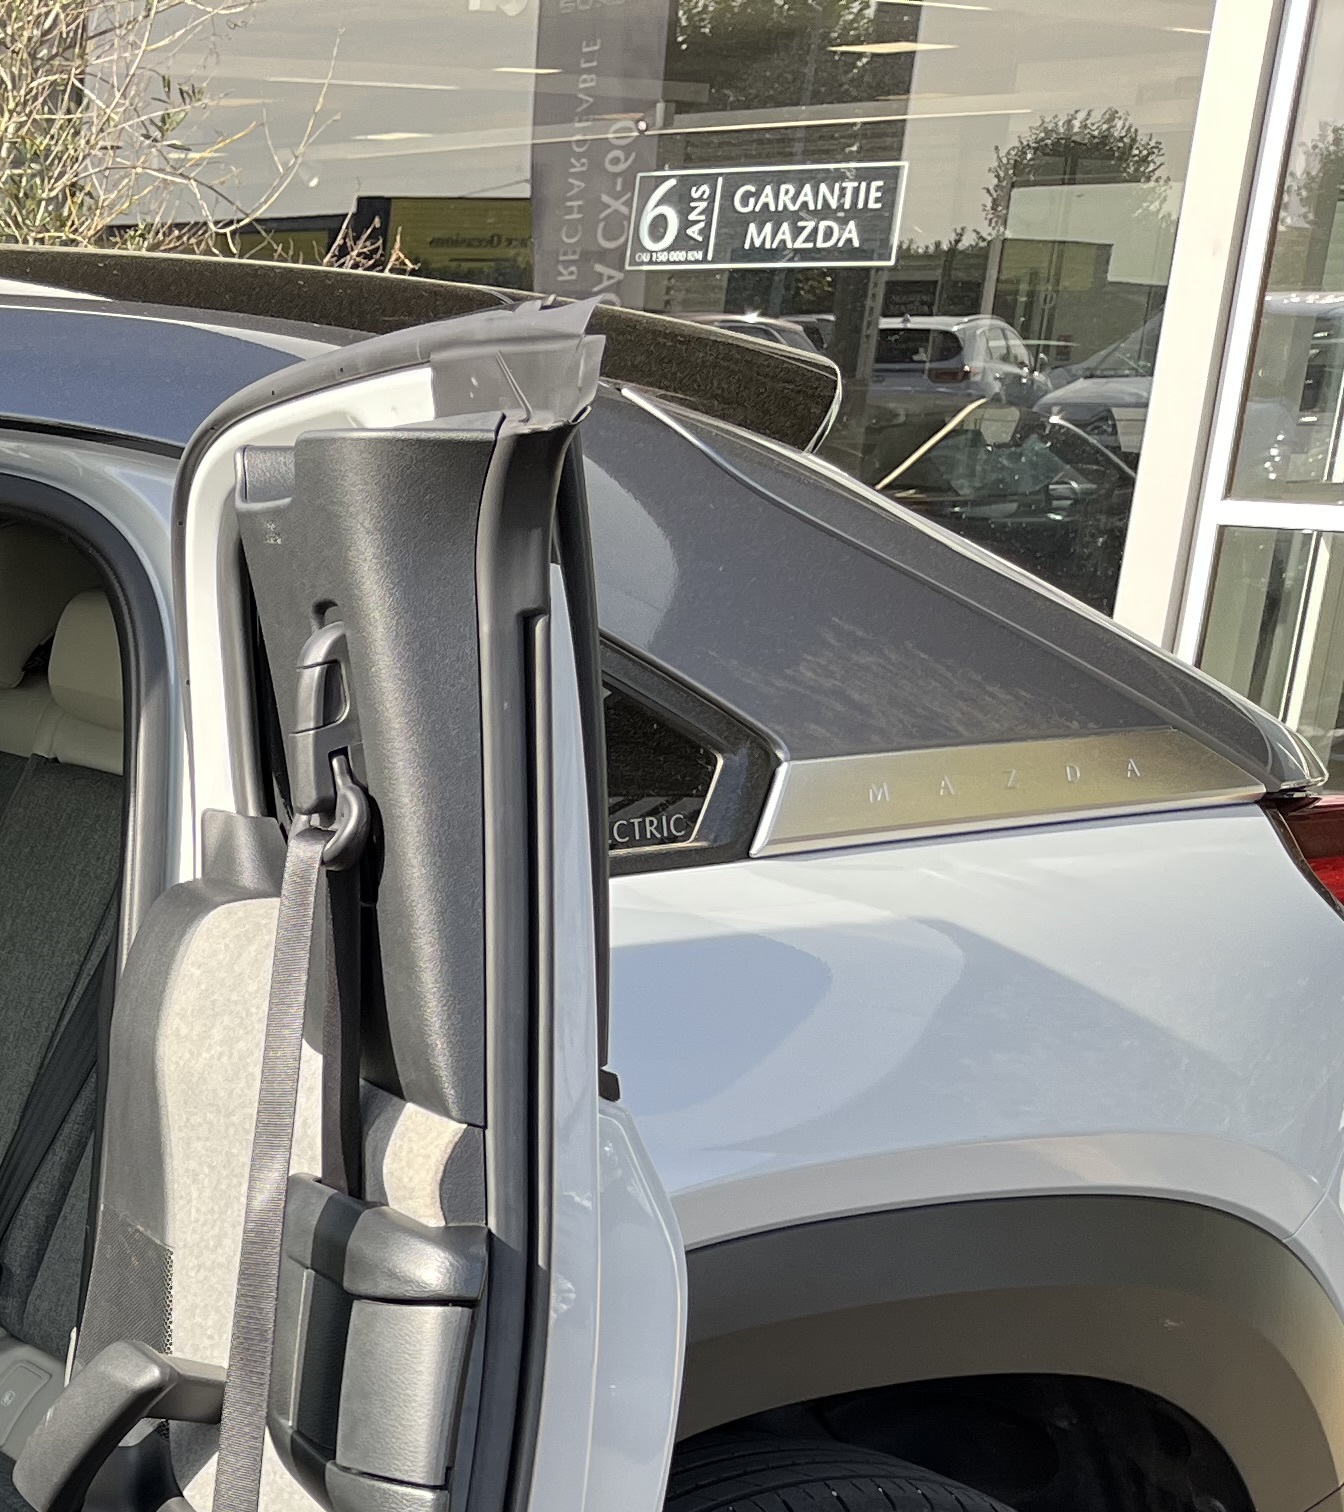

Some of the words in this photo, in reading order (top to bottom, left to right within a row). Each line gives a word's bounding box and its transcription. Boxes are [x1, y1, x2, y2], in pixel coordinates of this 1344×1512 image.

[733, 180, 885, 214] GARANTIE
[639, 178, 678, 251] 6
[686, 184, 710, 241] ANS
[743, 220, 860, 250] MAZDA
[869, 757, 1141, 803] MAZDA
[608, 813, 687, 843] CTRIC
